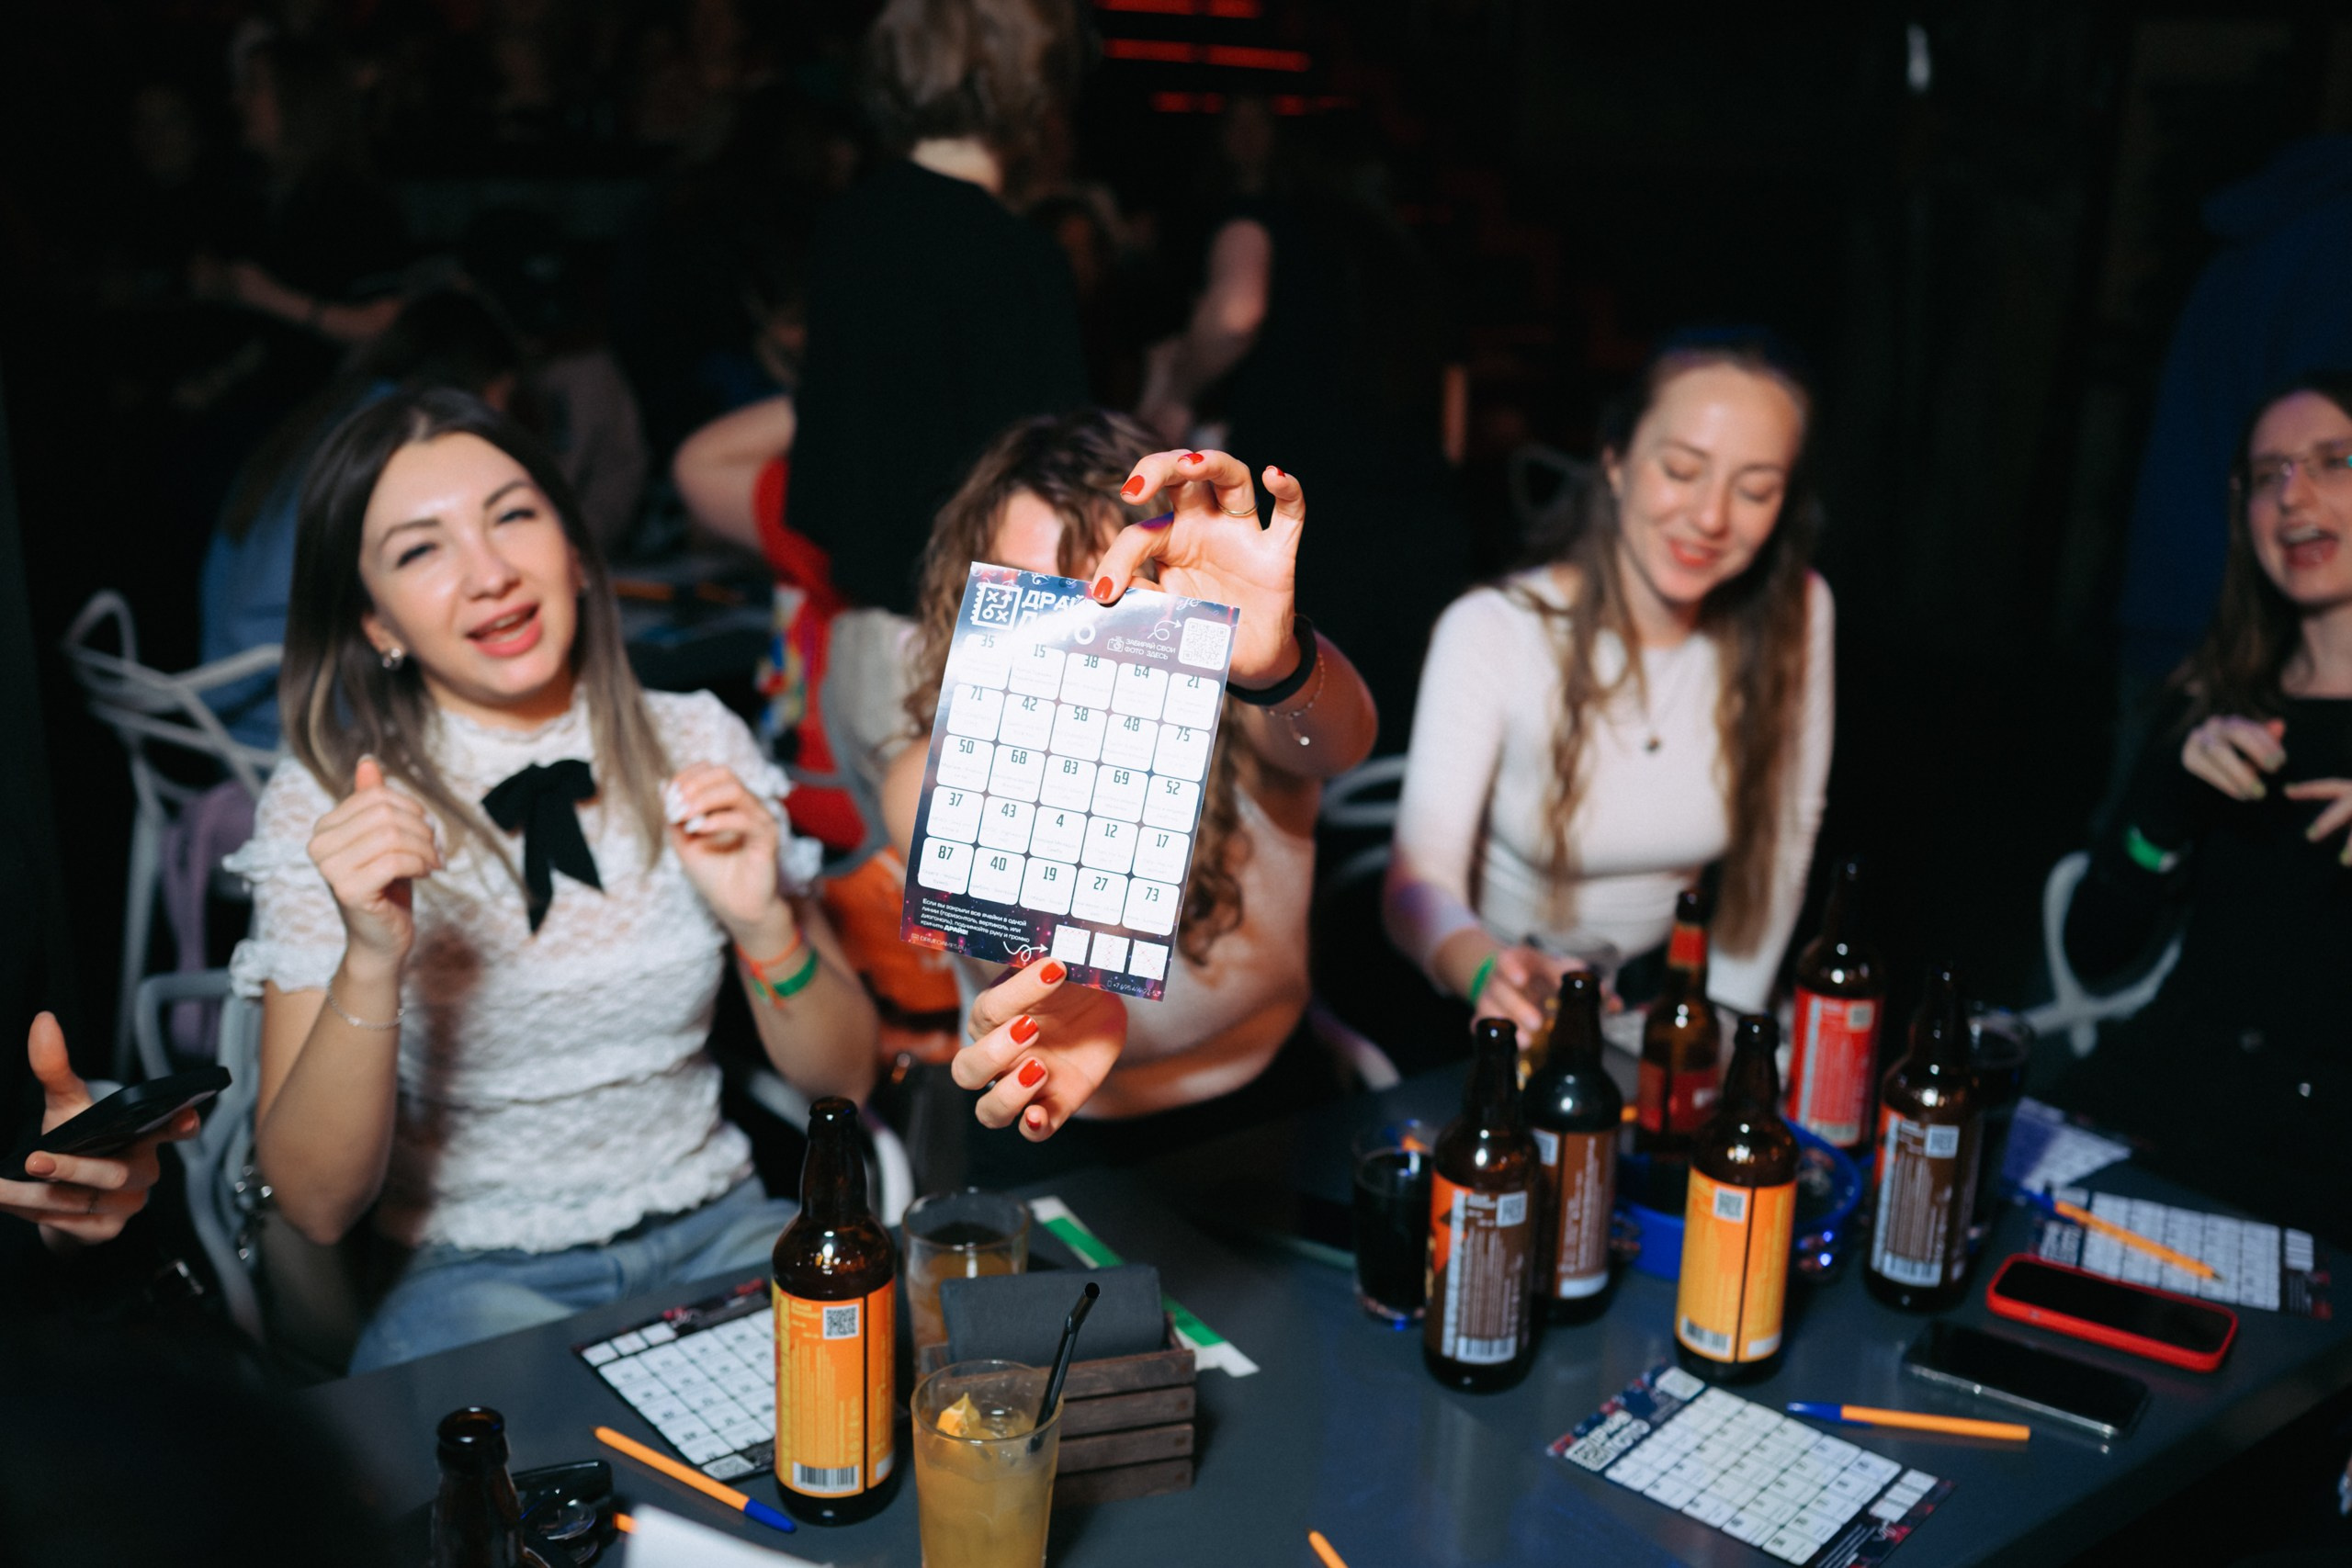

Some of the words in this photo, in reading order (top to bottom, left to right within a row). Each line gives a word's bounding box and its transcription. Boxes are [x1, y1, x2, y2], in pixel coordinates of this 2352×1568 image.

[981, 634, 995, 649] 35
[1125, 638, 1156, 649] ЗАБИРАЙ
[1156, 644, 1176, 654] СВОИ
[1034, 644, 1046, 658] 15
[1124, 646, 1145, 656] ФОТО
[1147, 650, 1169, 660] ЗДЕСЬ
[1083, 654, 1099, 669] 38
[1134, 664, 1150, 679] 64
[1187, 675, 1200, 689] 21
[970, 686, 983, 701] 71
[1022, 697, 1037, 712] 42
[1073, 706, 1089, 721] 58
[1124, 716, 1140, 731] 48
[1176, 727, 1191, 741] 75
[959, 739, 975, 754] 50
[1011, 750, 1027, 764] 68
[1063, 760, 1079, 774] 83
[1114, 770, 1130, 784] 69
[1166, 780, 1181, 795] 52
[948, 792, 964, 807] 37
[1001, 803, 1017, 818] 43
[1056, 814, 1065, 828] 4
[1104, 823, 1118, 838] 12
[1156, 834, 1170, 848] 17
[938, 845, 954, 860] 87
[990, 856, 1007, 871] 40
[1043, 866, 1057, 881] 19
[1093, 876, 1109, 891] 27
[1145, 887, 1159, 902] 73
[922, 897, 937, 907] Если
[1008, 919, 1027, 927] одной
[944, 924, 968, 936] ДРАЙВ!
[989, 929, 1003, 938] руку
[1008, 932, 1030, 943] громко
